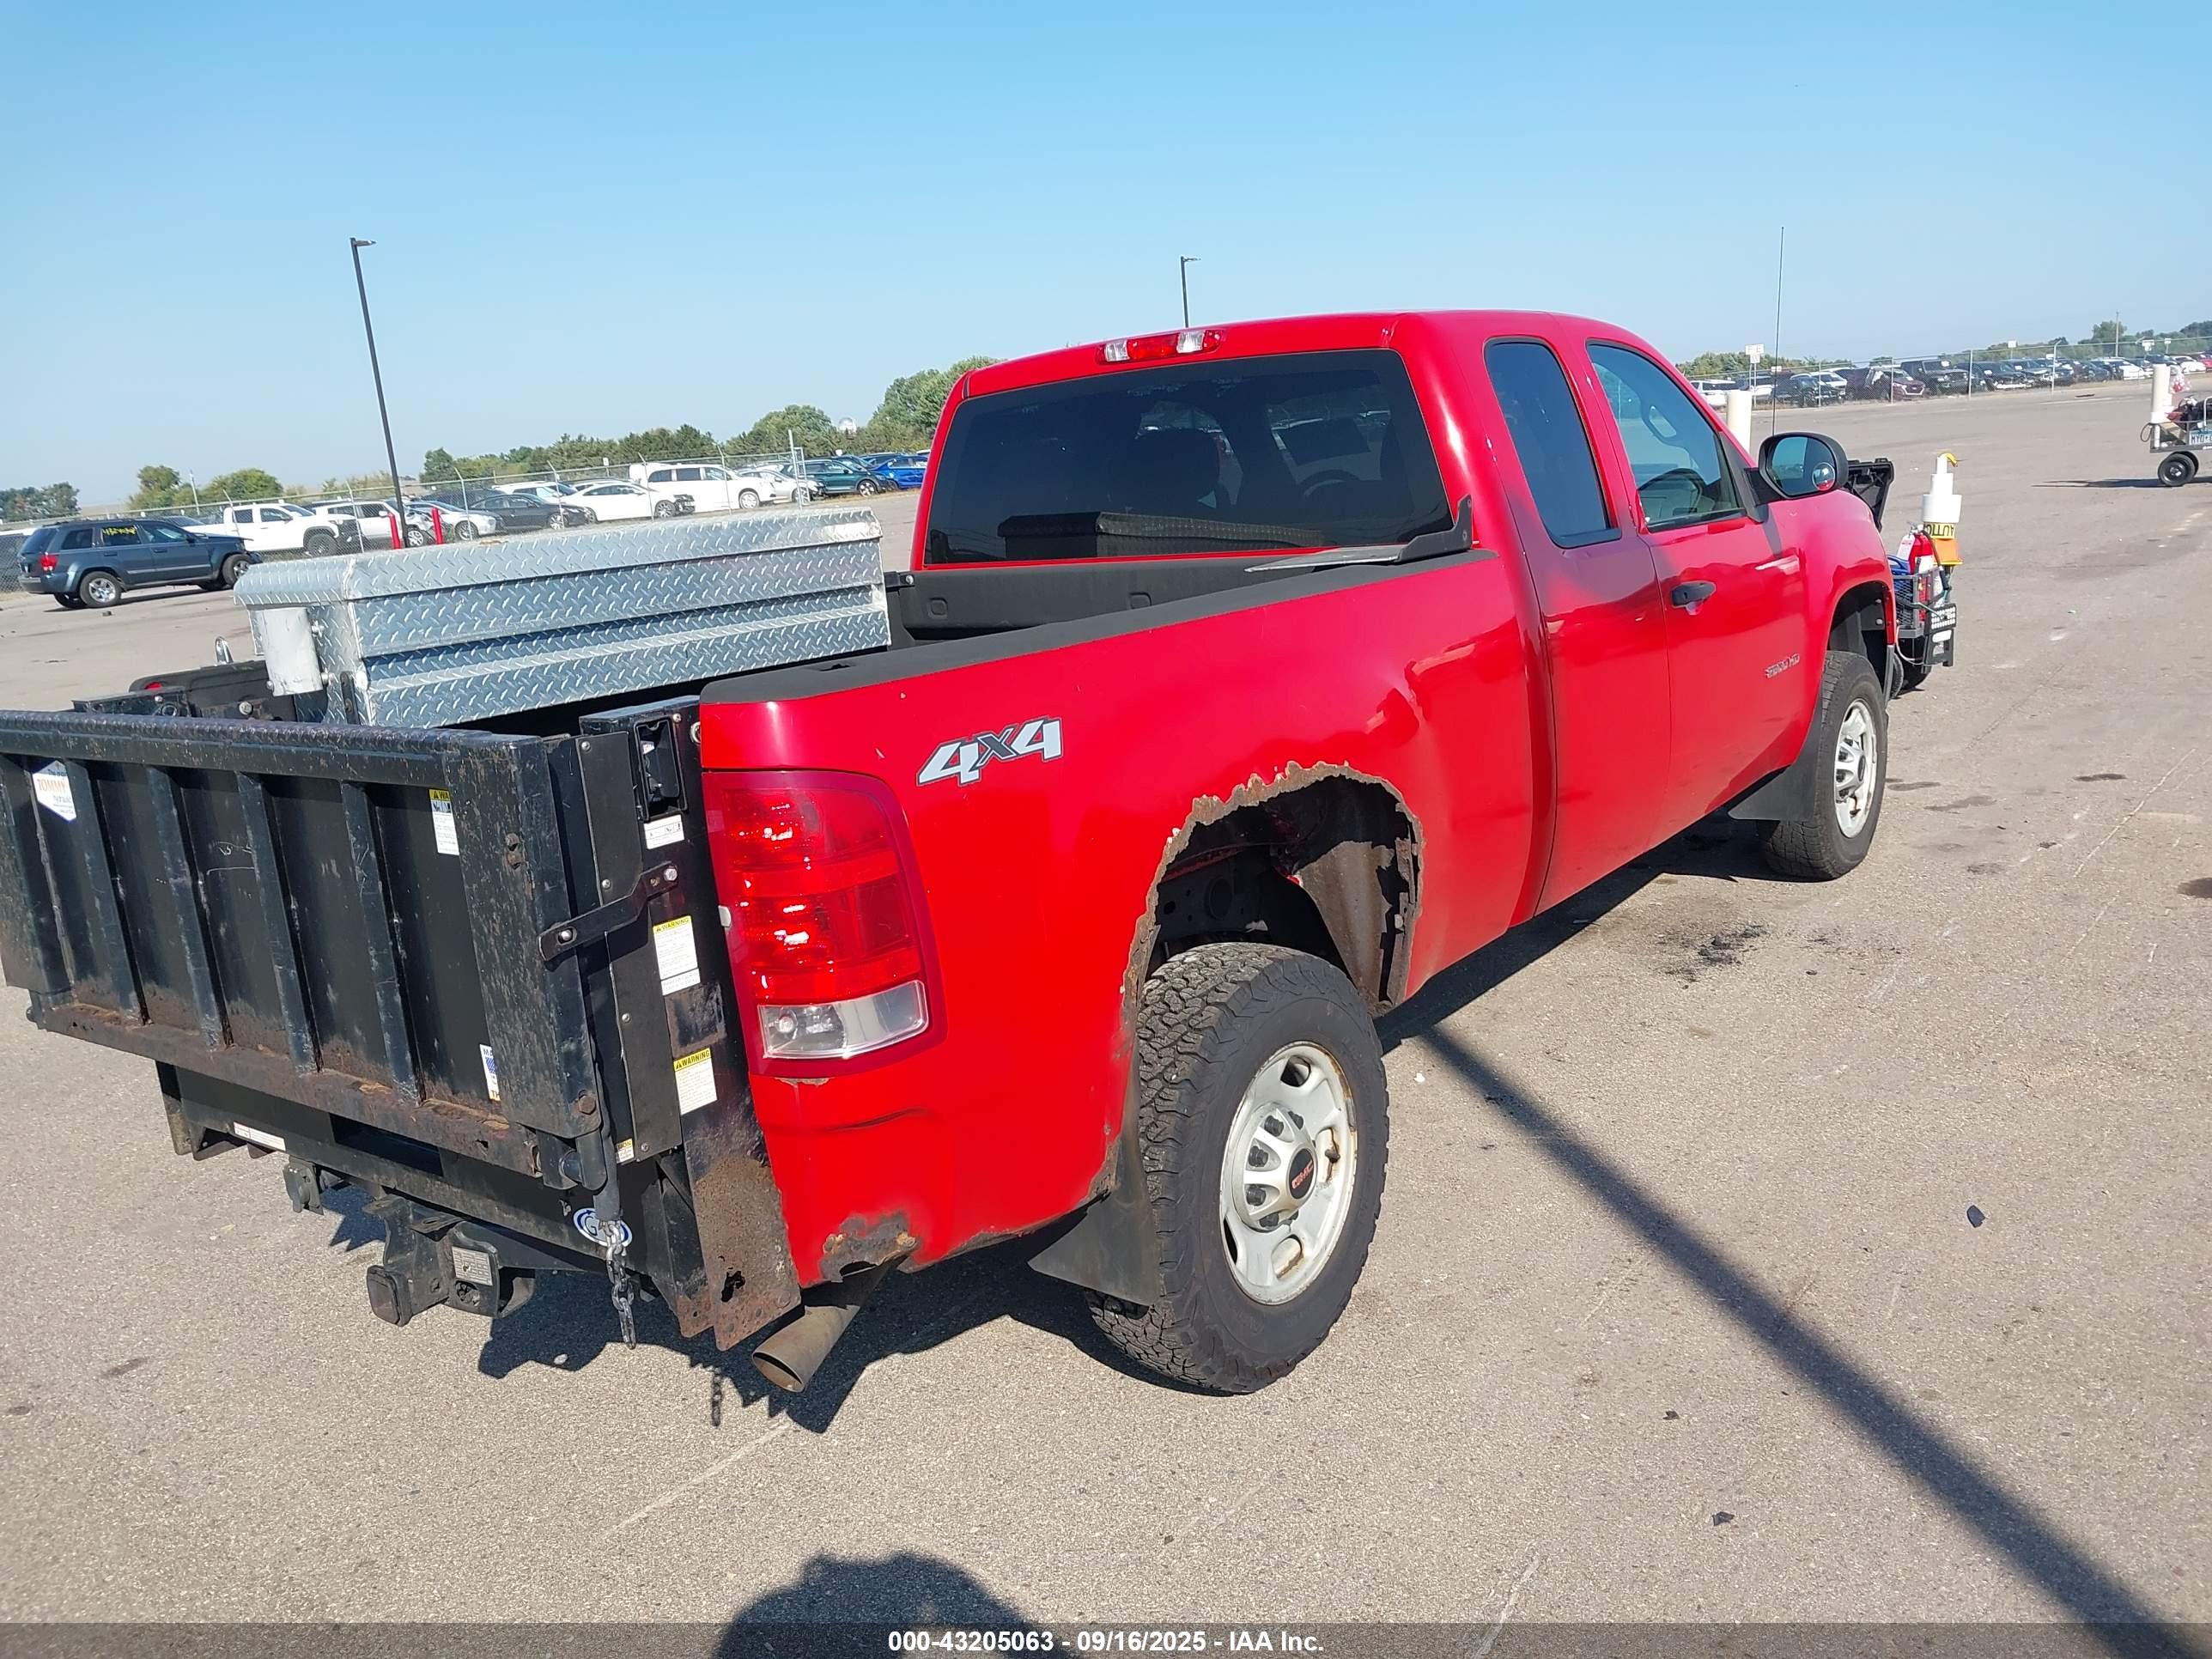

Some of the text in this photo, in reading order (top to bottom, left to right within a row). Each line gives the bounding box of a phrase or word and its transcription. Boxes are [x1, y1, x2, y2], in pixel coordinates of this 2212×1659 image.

[661, 918, 689, 931] WARNING
[681, 1049, 710, 1067] WARNING
[1291, 1159, 1314, 1189] GMC
